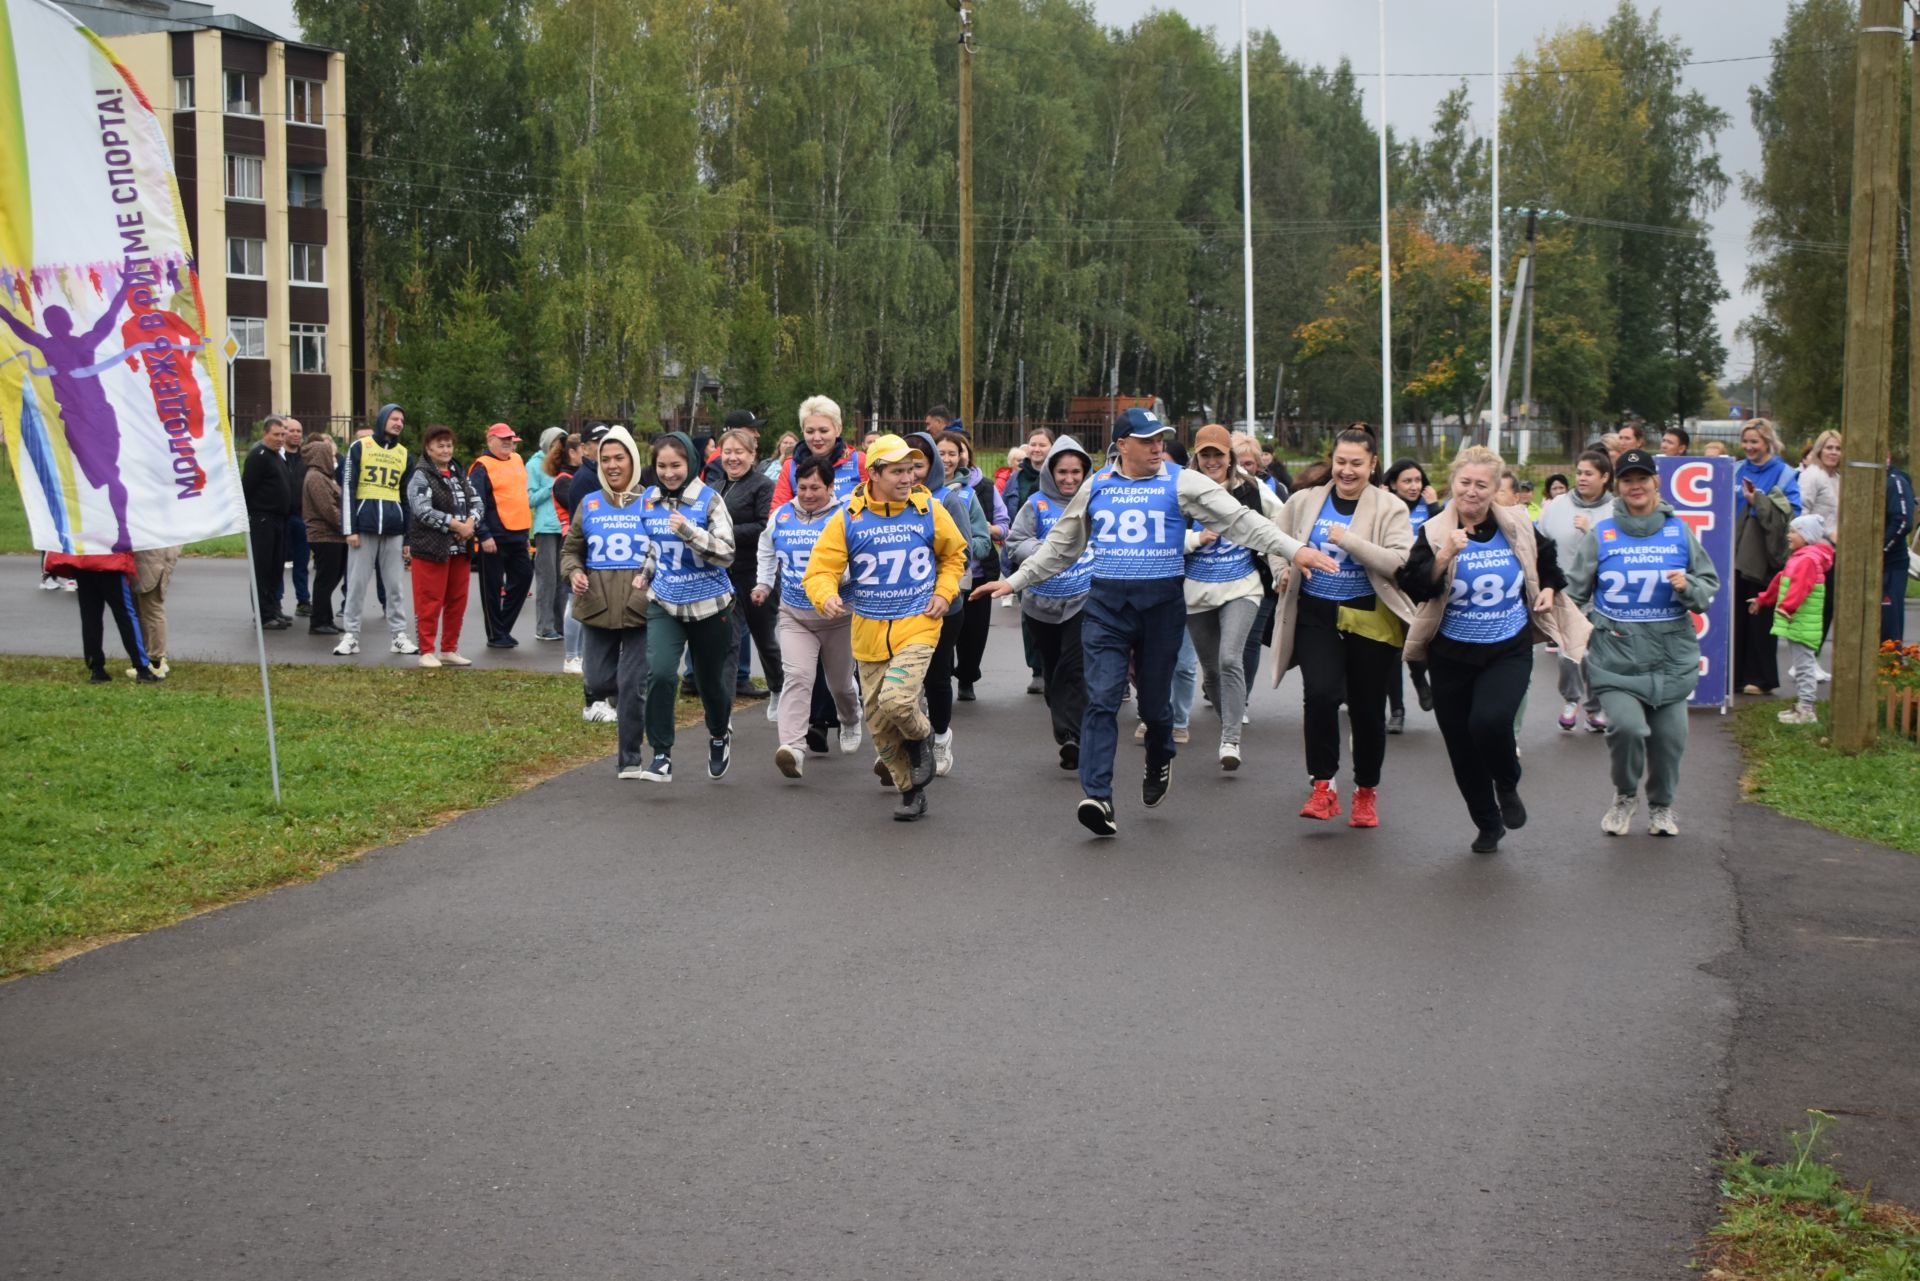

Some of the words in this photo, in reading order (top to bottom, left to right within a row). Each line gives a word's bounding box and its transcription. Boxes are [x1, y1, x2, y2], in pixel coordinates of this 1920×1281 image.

[95, 88, 138, 204] СПОРТА!
[116, 210, 160, 305] РИТМЕ
[138, 312, 166, 330] В
[147, 335, 203, 500] МОЛОДЕЖЬ
[363, 466, 400, 488] 315
[1100, 487, 1166, 495] ТУКАЕВСКИЙ
[1112, 495, 1149, 504] РАЙОН
[603, 521, 636, 529] РАЙОН
[856, 524, 924, 539] ТУКАЕВСКИЙ
[1093, 509, 1166, 543] 281
[787, 536, 817, 545] РАЙОН
[874, 534, 911, 545] РАЙОН
[587, 533, 650, 562] 283
[1607, 544, 1678, 555] ТУКАЕВСКИЙ
[853, 546, 932, 585] 278
[1467, 558, 1510, 570] РАЙОН
[1624, 554, 1664, 564] РАЙОН
[880, 588, 913, 598] НОРМА
